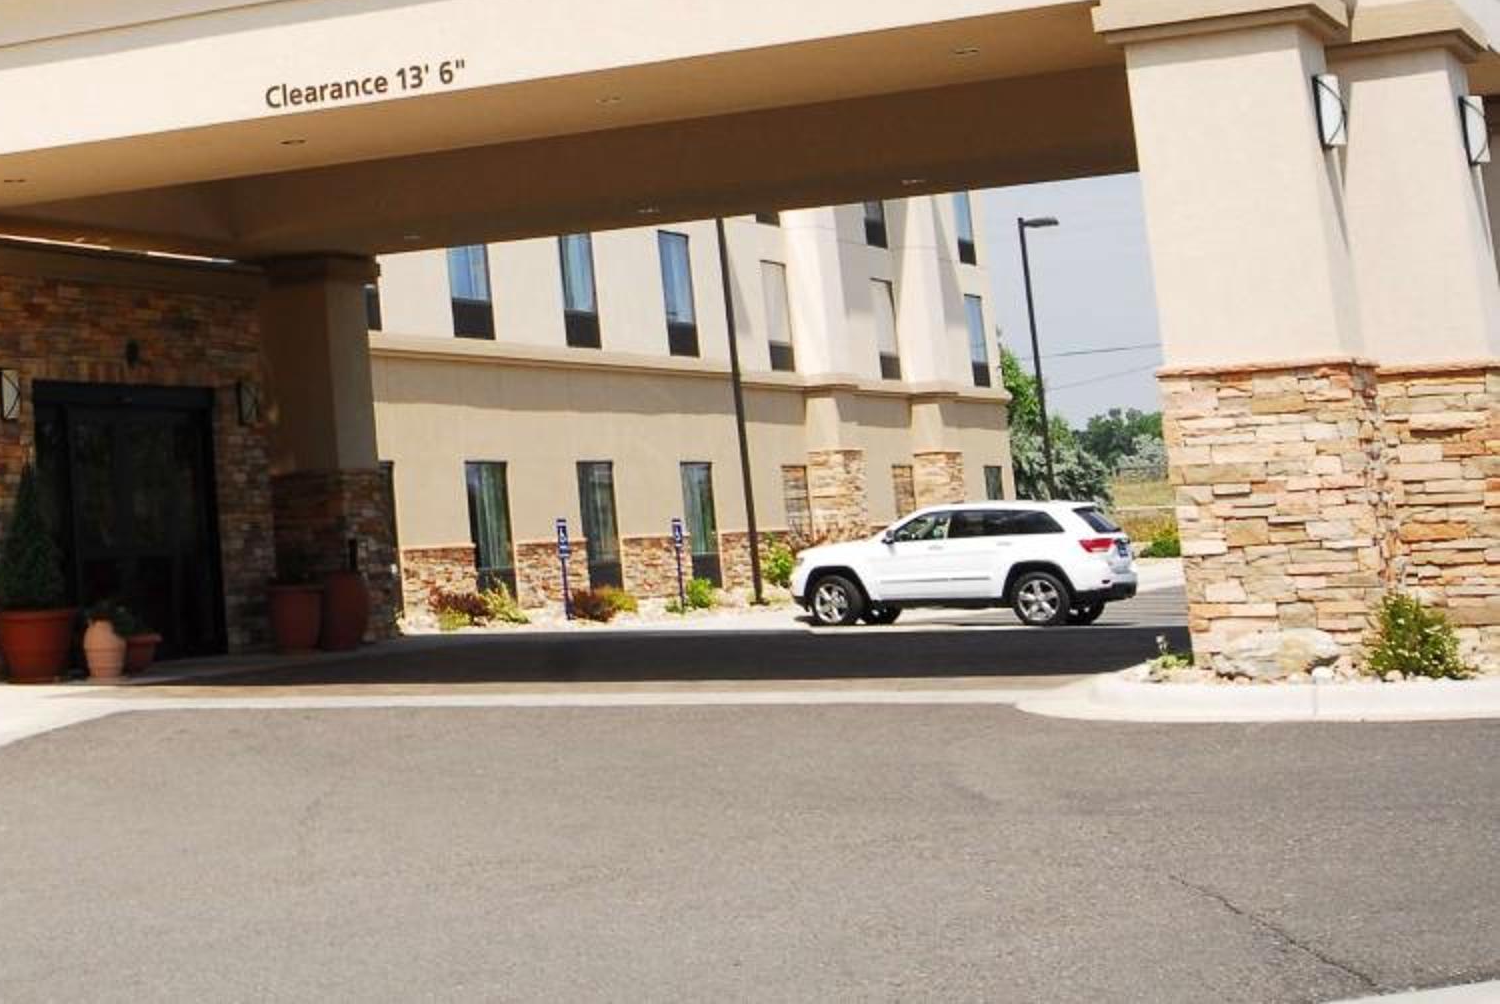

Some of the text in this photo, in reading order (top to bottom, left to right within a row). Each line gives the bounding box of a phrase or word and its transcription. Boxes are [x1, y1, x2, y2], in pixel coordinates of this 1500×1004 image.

[265, 59, 466, 108] Clearance 13' 6"
